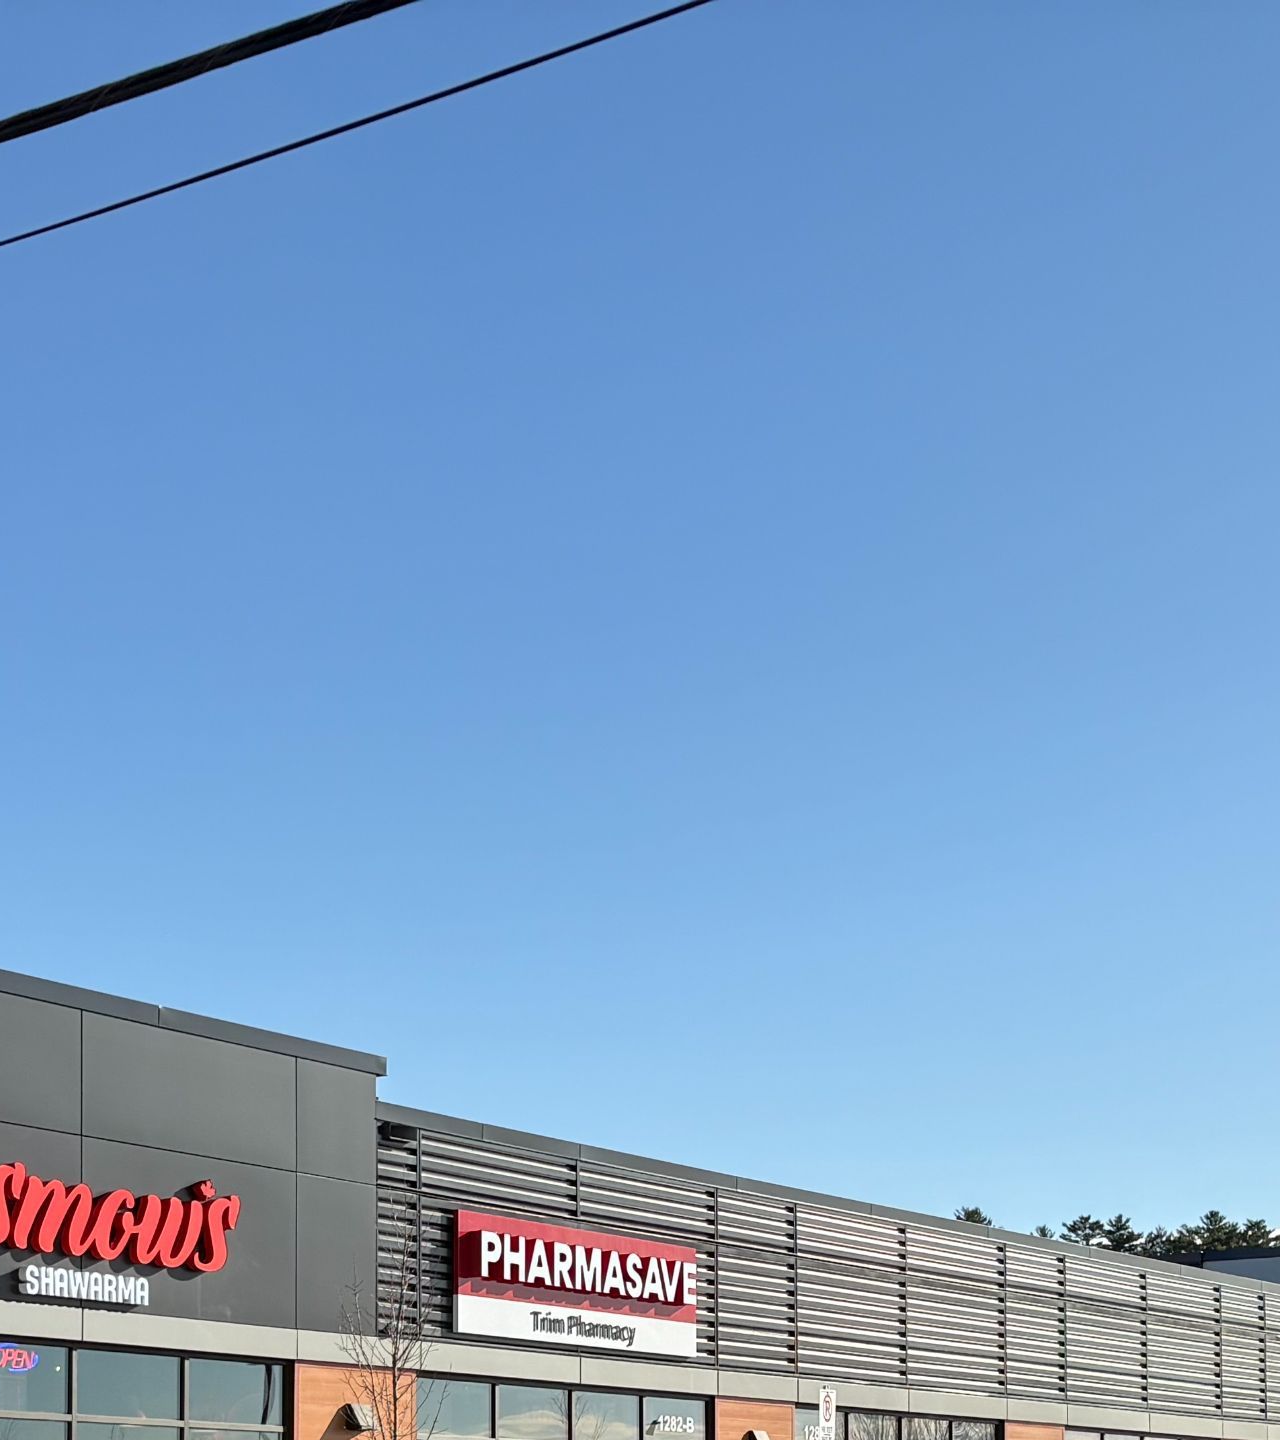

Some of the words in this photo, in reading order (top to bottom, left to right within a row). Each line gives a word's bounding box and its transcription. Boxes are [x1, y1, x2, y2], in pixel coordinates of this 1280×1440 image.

[21, 1264, 150, 1307] SHAWARMA
[480, 1229, 698, 1306] PHARMASAVE
[530, 1310, 566, 1336] Trim
[566, 1314, 637, 1348] Pharmacy
[657, 1414, 696, 1434] 1282-B
